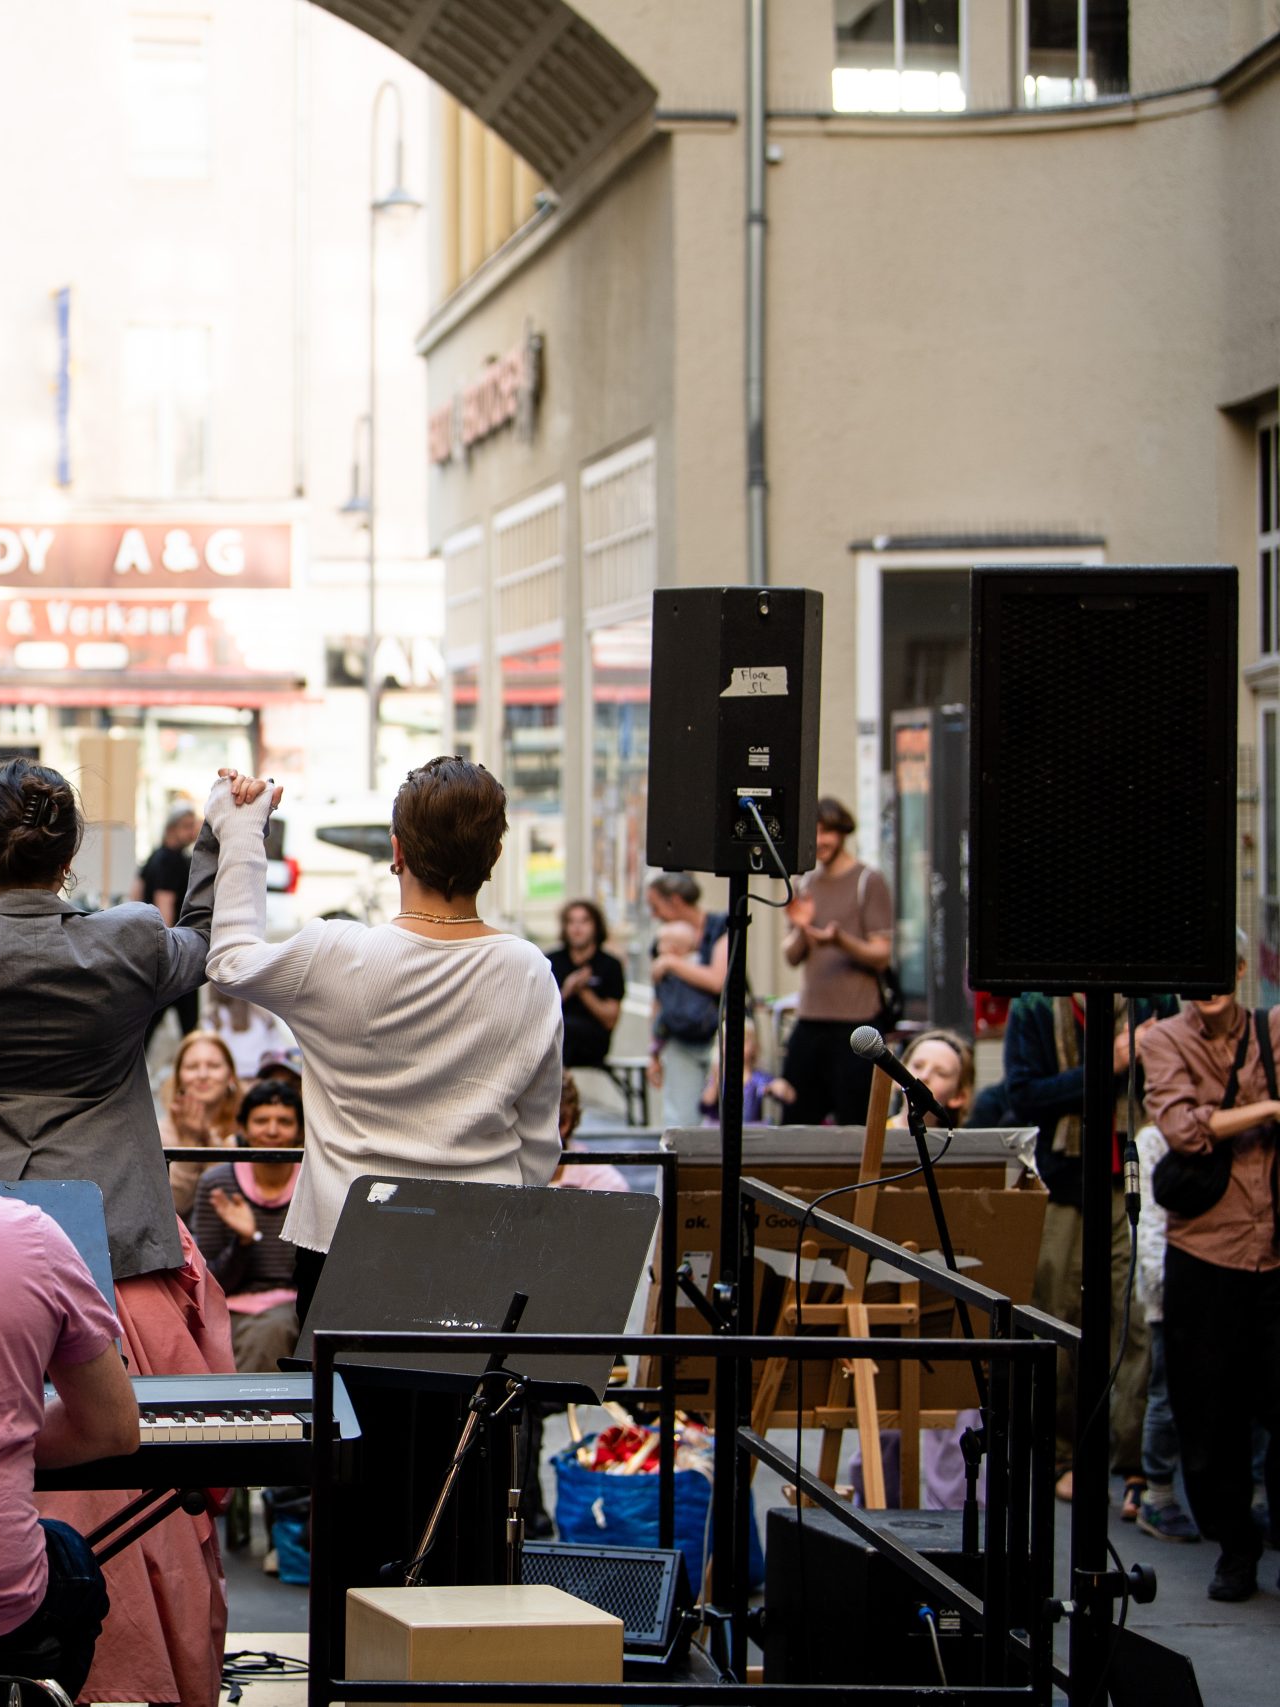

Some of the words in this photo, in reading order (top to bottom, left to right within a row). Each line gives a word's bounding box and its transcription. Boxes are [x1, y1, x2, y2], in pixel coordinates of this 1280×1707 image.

[114, 528, 152, 574] A
[162, 529, 199, 573] &
[205, 529, 245, 576] G
[747, 681, 768, 694] SL
